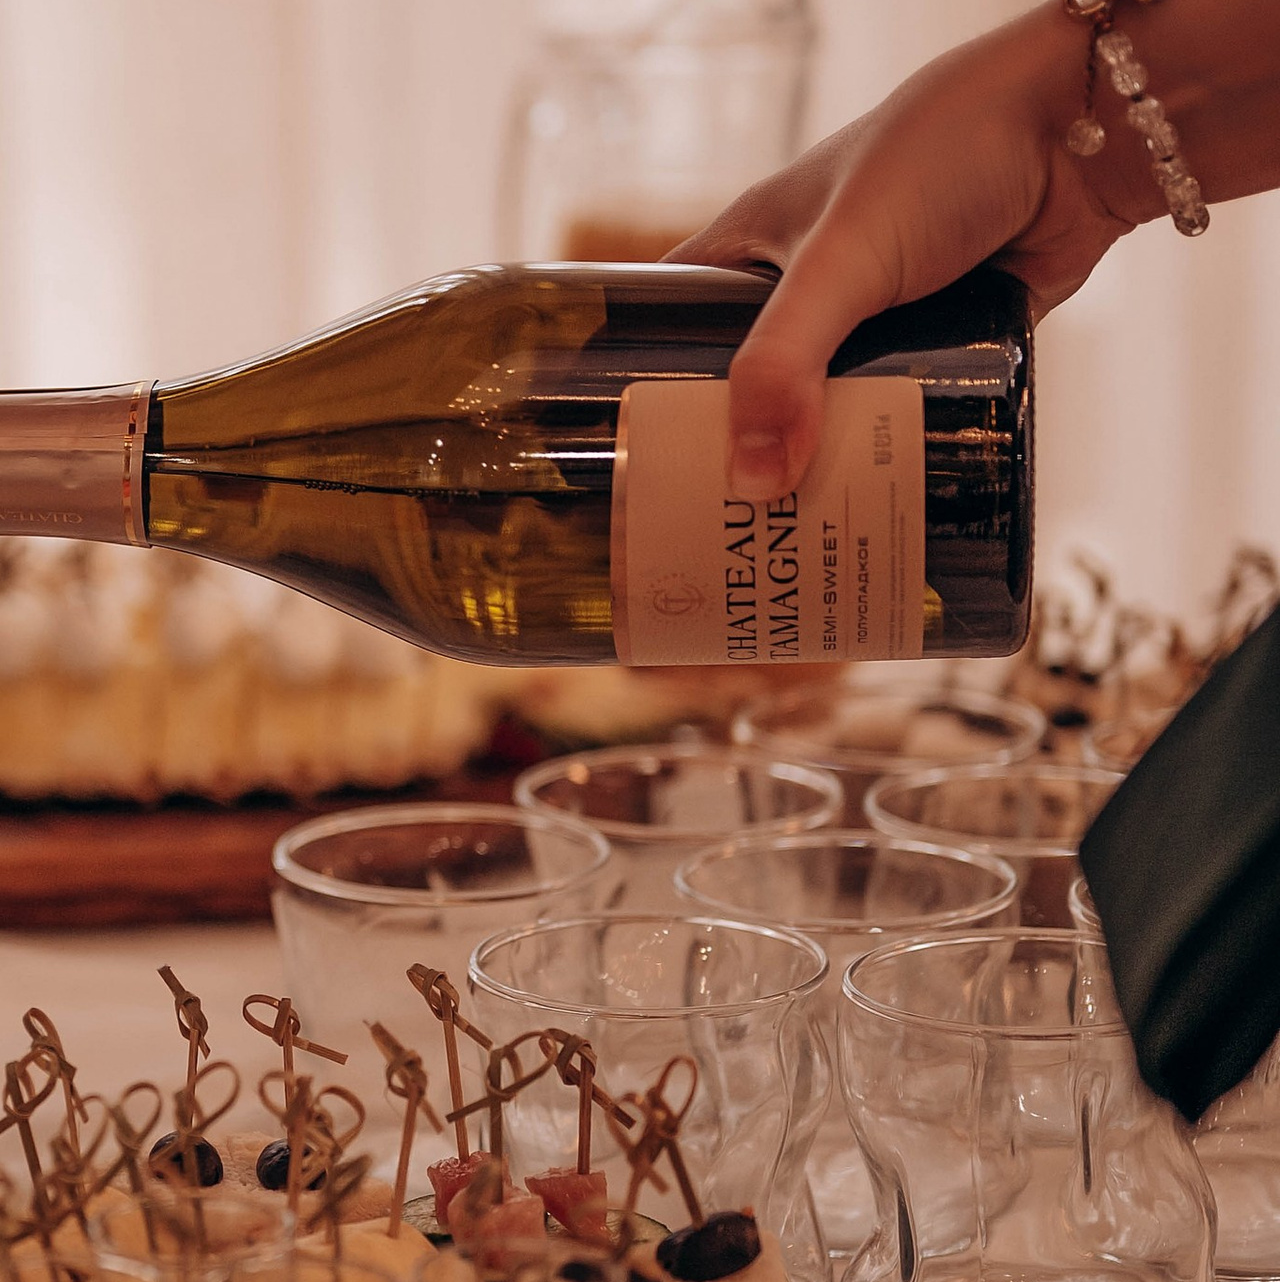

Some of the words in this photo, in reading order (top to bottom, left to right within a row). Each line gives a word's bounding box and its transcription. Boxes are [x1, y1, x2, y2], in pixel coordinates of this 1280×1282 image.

[724, 499, 758, 660] CHATEAU
[767, 491, 799, 660] TAMAGNE
[823, 520, 837, 651] SEMI-SWEET
[858, 536, 868, 644] ПОЛУСЛАДКОЕ
